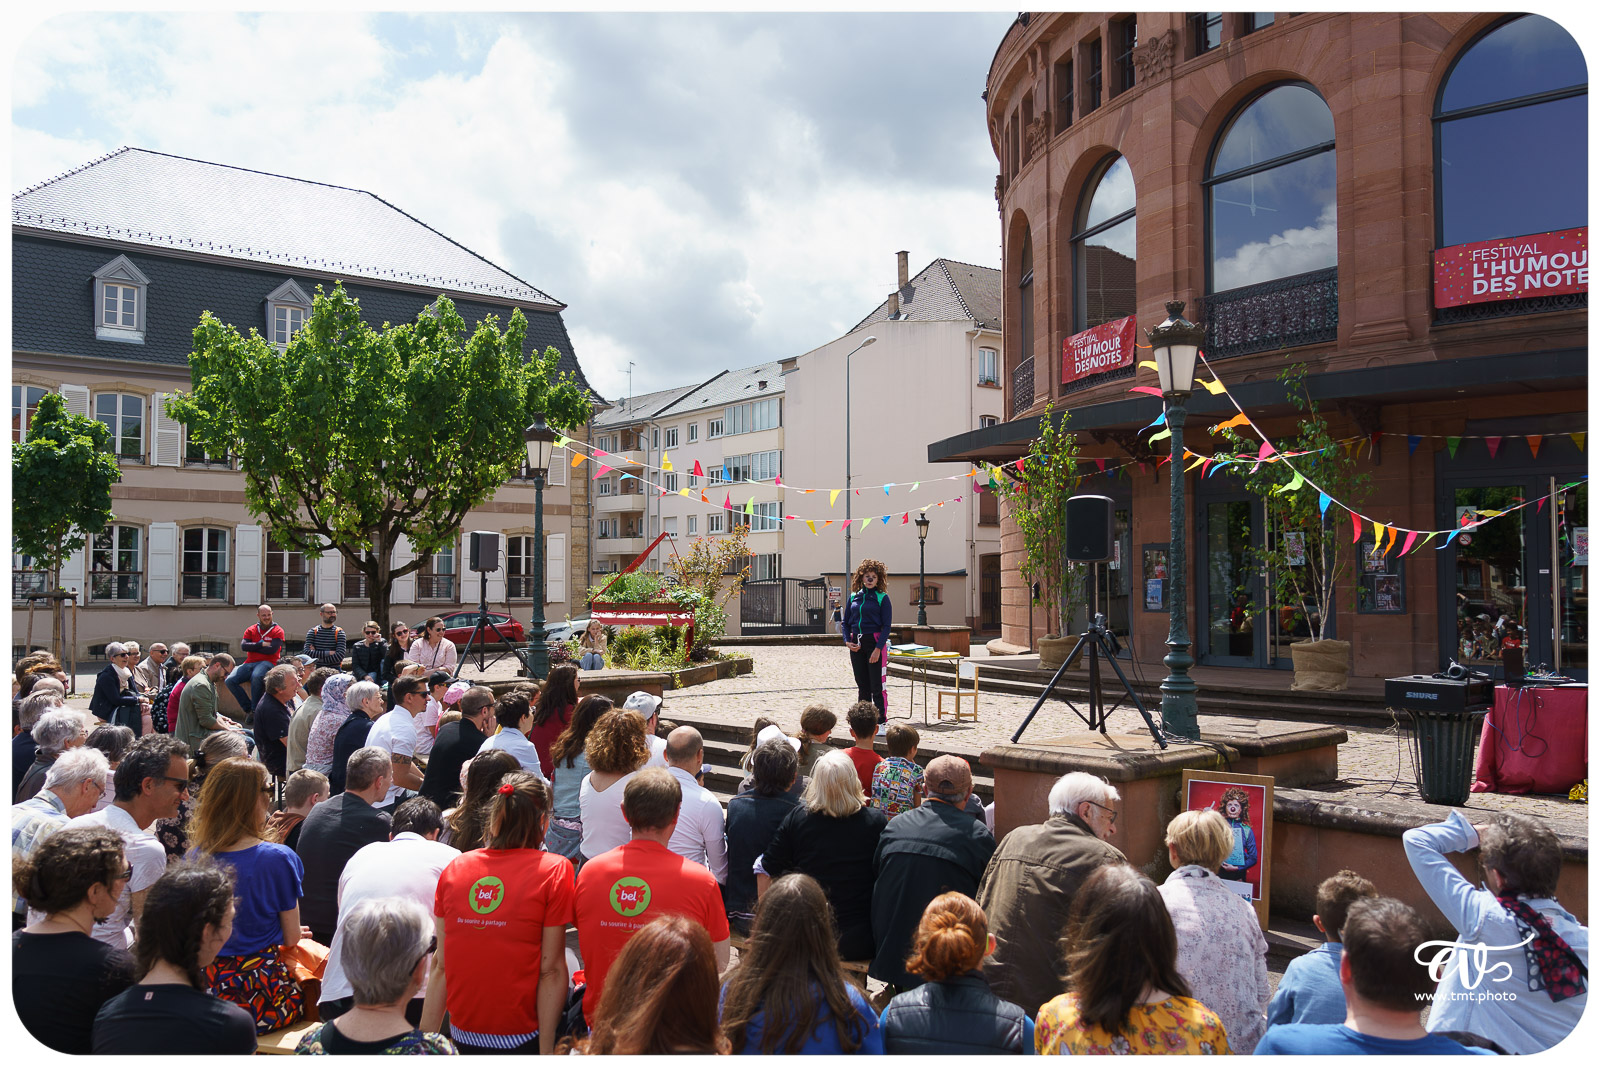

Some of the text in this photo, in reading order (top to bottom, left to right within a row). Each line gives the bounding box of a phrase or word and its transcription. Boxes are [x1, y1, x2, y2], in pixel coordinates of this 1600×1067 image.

[1472, 243, 1542, 262] FESTIVAL
[1472, 250, 1588, 278] L'HUMOU
[1473, 268, 1589, 295] DES NOTE
[1074, 336, 1122, 362] L'HUMOUR
[1075, 350, 1122, 374] DES NOTES
[1405, 691, 1438, 700] SHURE
[478, 889, 493, 900] bel
[621, 890, 637, 901] bel
